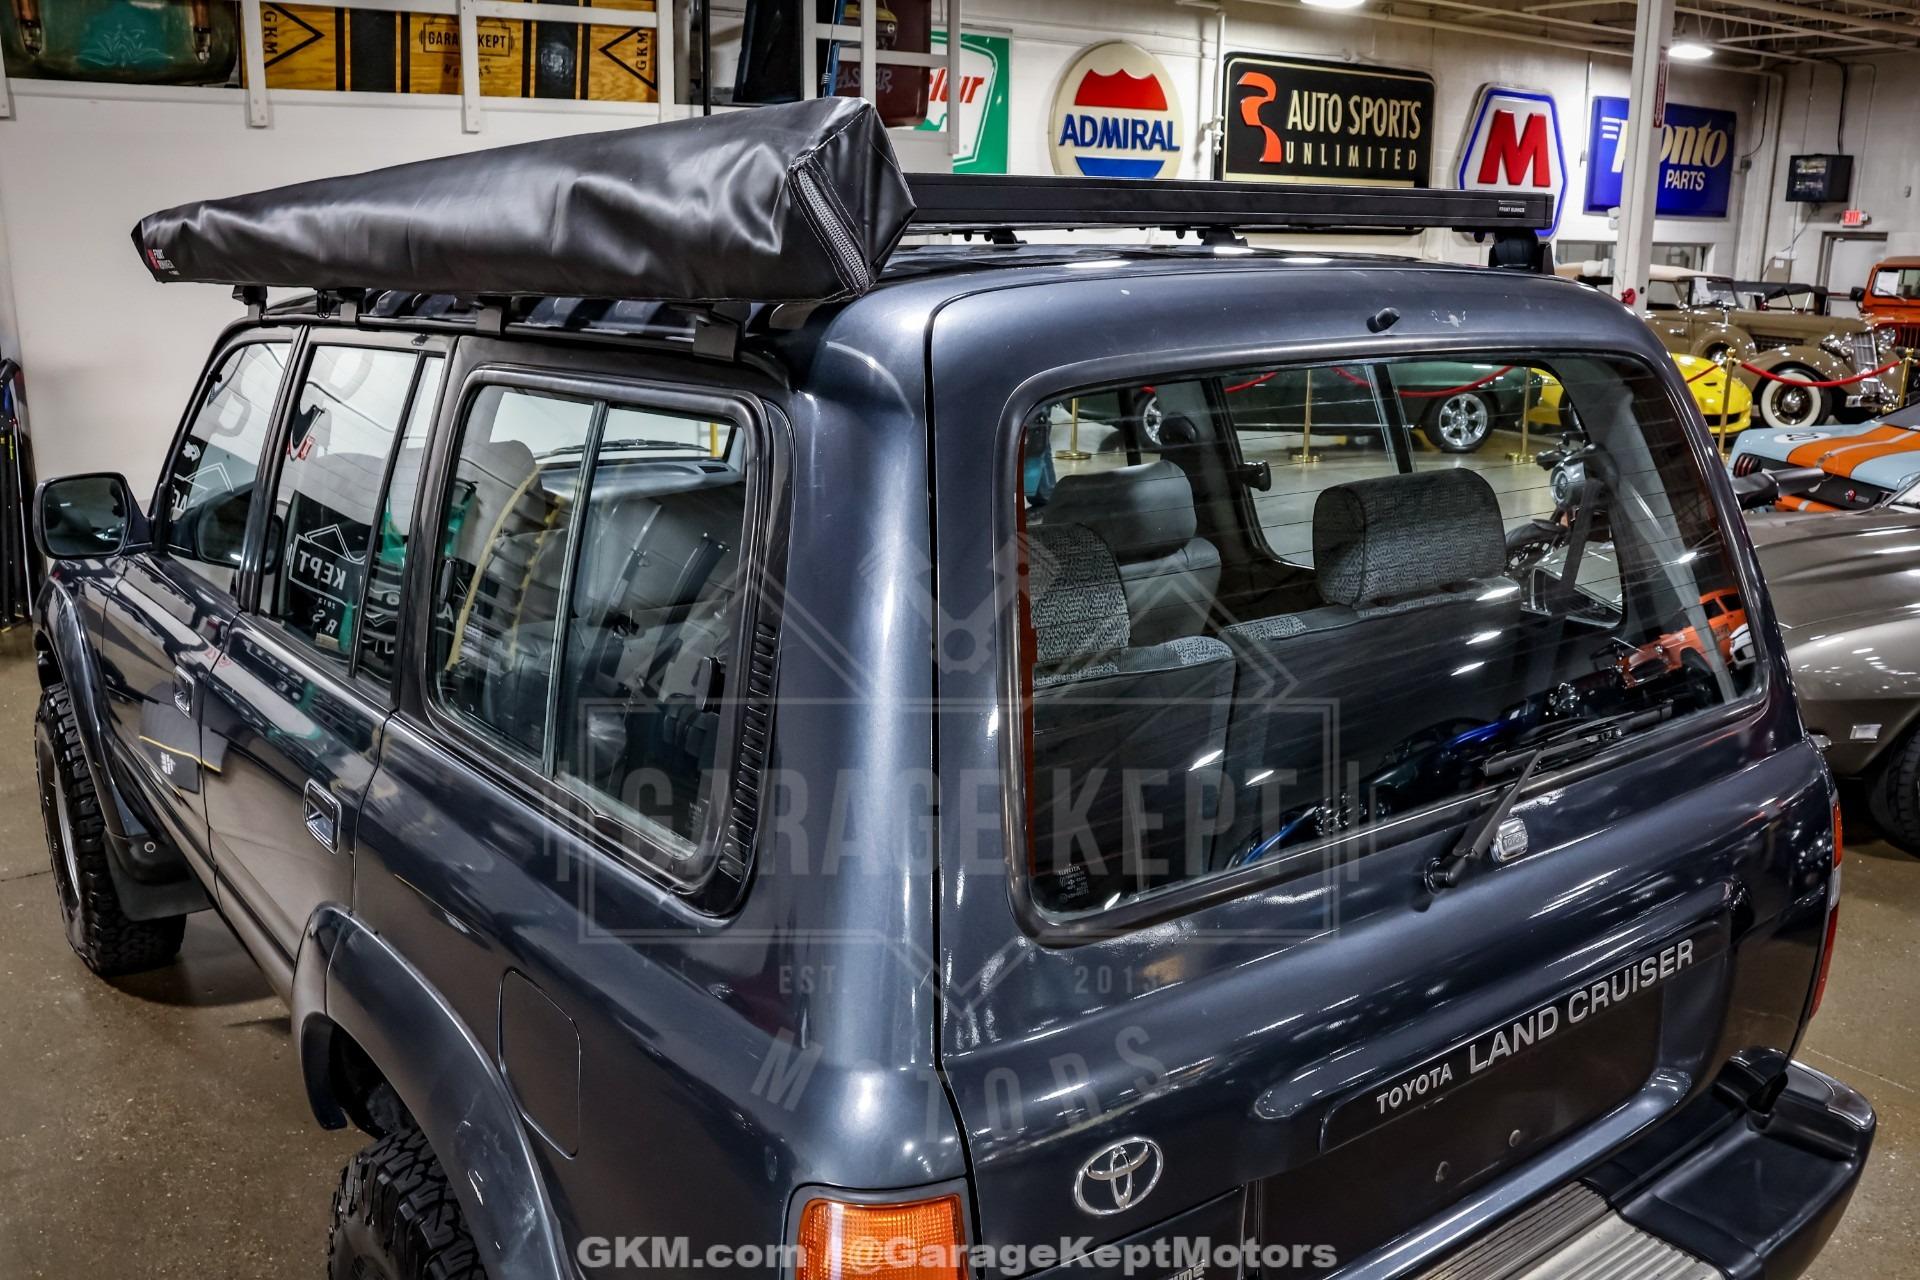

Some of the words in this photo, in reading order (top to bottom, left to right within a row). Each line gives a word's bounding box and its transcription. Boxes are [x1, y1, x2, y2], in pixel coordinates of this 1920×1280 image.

[263, 10, 278, 55] GKM
[428, 31, 460, 46] GARA
[477, 34, 507, 49] KEPT
[636, 31, 649, 71] GKM
[1058, 113, 1181, 152] ADMIRAL
[1286, 89, 1343, 134] AUTO
[1347, 94, 1422, 140] SPORTS
[1285, 141, 1417, 171] UNLIMITED
[1477, 109, 1551, 188] M
[1664, 169, 1706, 191] PARTS
[1376, 1062, 1453, 1114] TOYOTA
[1469, 1006, 1559, 1075] LAND
[1568, 938, 1694, 1025] CRUISER
